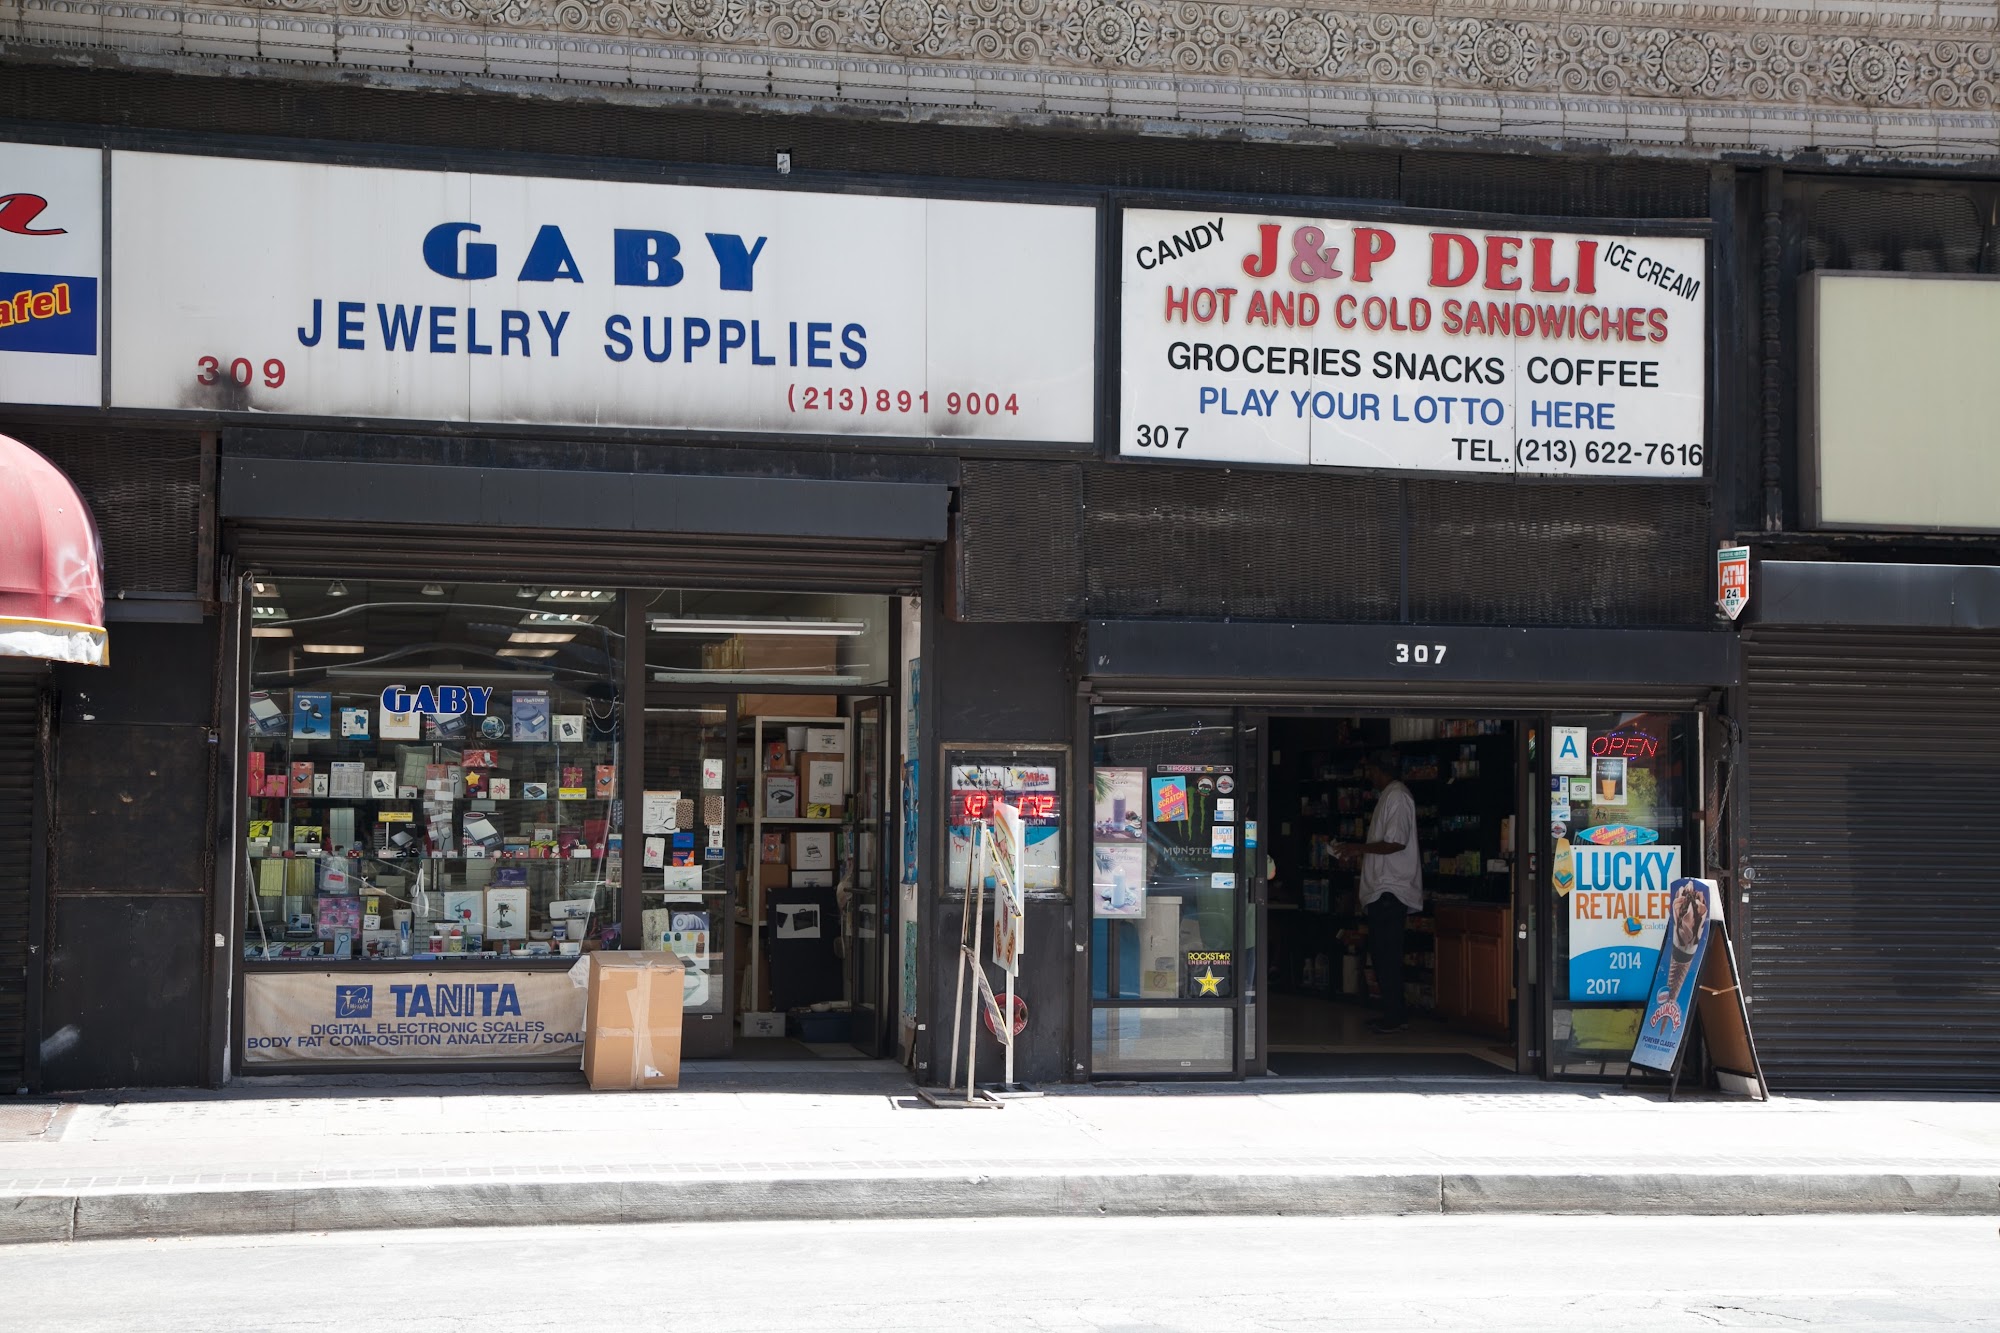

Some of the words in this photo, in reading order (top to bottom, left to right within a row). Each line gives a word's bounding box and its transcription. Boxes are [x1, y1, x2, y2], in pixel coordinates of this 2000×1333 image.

[423, 222, 767, 291] GABY
[1136, 218, 1225, 270] CANDY
[1242, 224, 1395, 282] J&P
[1429, 232, 1598, 294] DELI
[1604, 242, 1636, 271] ICE
[1637, 256, 1701, 302] CREAM
[1165, 286, 1236, 324] HOT
[1247, 291, 1319, 327] AND
[1336, 294, 1431, 332] COLD
[1441, 299, 1668, 343] SANDWICHES
[298, 299, 569, 357] JEWELRY
[604, 315, 867, 369] SUPPLIES
[197, 356, 285, 388] 309
[1168, 342, 1361, 376] GROCERIES
[1373, 352, 1504, 385] SNACKS
[1527, 357, 1659, 387] COFFEE
[946, 392, 1019, 415] 9004
[1200, 387, 1278, 417] PLAY
[1290, 391, 1380, 421] YOUR
[1394, 395, 1503, 425] LOTTO
[1531, 402, 1614, 430] HERE
[1137, 425, 1189, 449] 307
[1452, 439, 1509, 464] TEL.
[1516, 440, 1577, 467] (213)
[1586, 442, 1703, 467] 622-7616
[1722, 564, 1745, 586] ATM
[1726, 589, 1737, 598] 24
[1396, 643, 1446, 664] 307
[382, 684, 493, 715] GABY
[1560, 735, 1578, 758] A
[1591, 736, 1658, 756] OPEN
[1157, 791, 1185, 809] SCRATCH
[1216, 827, 1233, 835] LUCKY
[1576, 852, 1675, 891] LUCKY
[1609, 952, 1642, 969] 2014
[1586, 979, 1620, 994] 2017
[390, 984, 521, 1018] TANITA
[311, 1023, 367, 1035] DIGITAL
[377, 1022, 478, 1035] ELECTRONIC
[483, 1021, 545, 1033] SCALES
[1650, 1002, 1682, 1033] DRUMSTICK
[247, 1037, 292, 1048] BODY
[299, 1036, 323, 1047] FAT
[329, 1034, 443, 1047] COMPOSITION
[446, 1032, 530, 1045] ANALYZER
[1642, 1035, 1660, 1046] FOREVER
